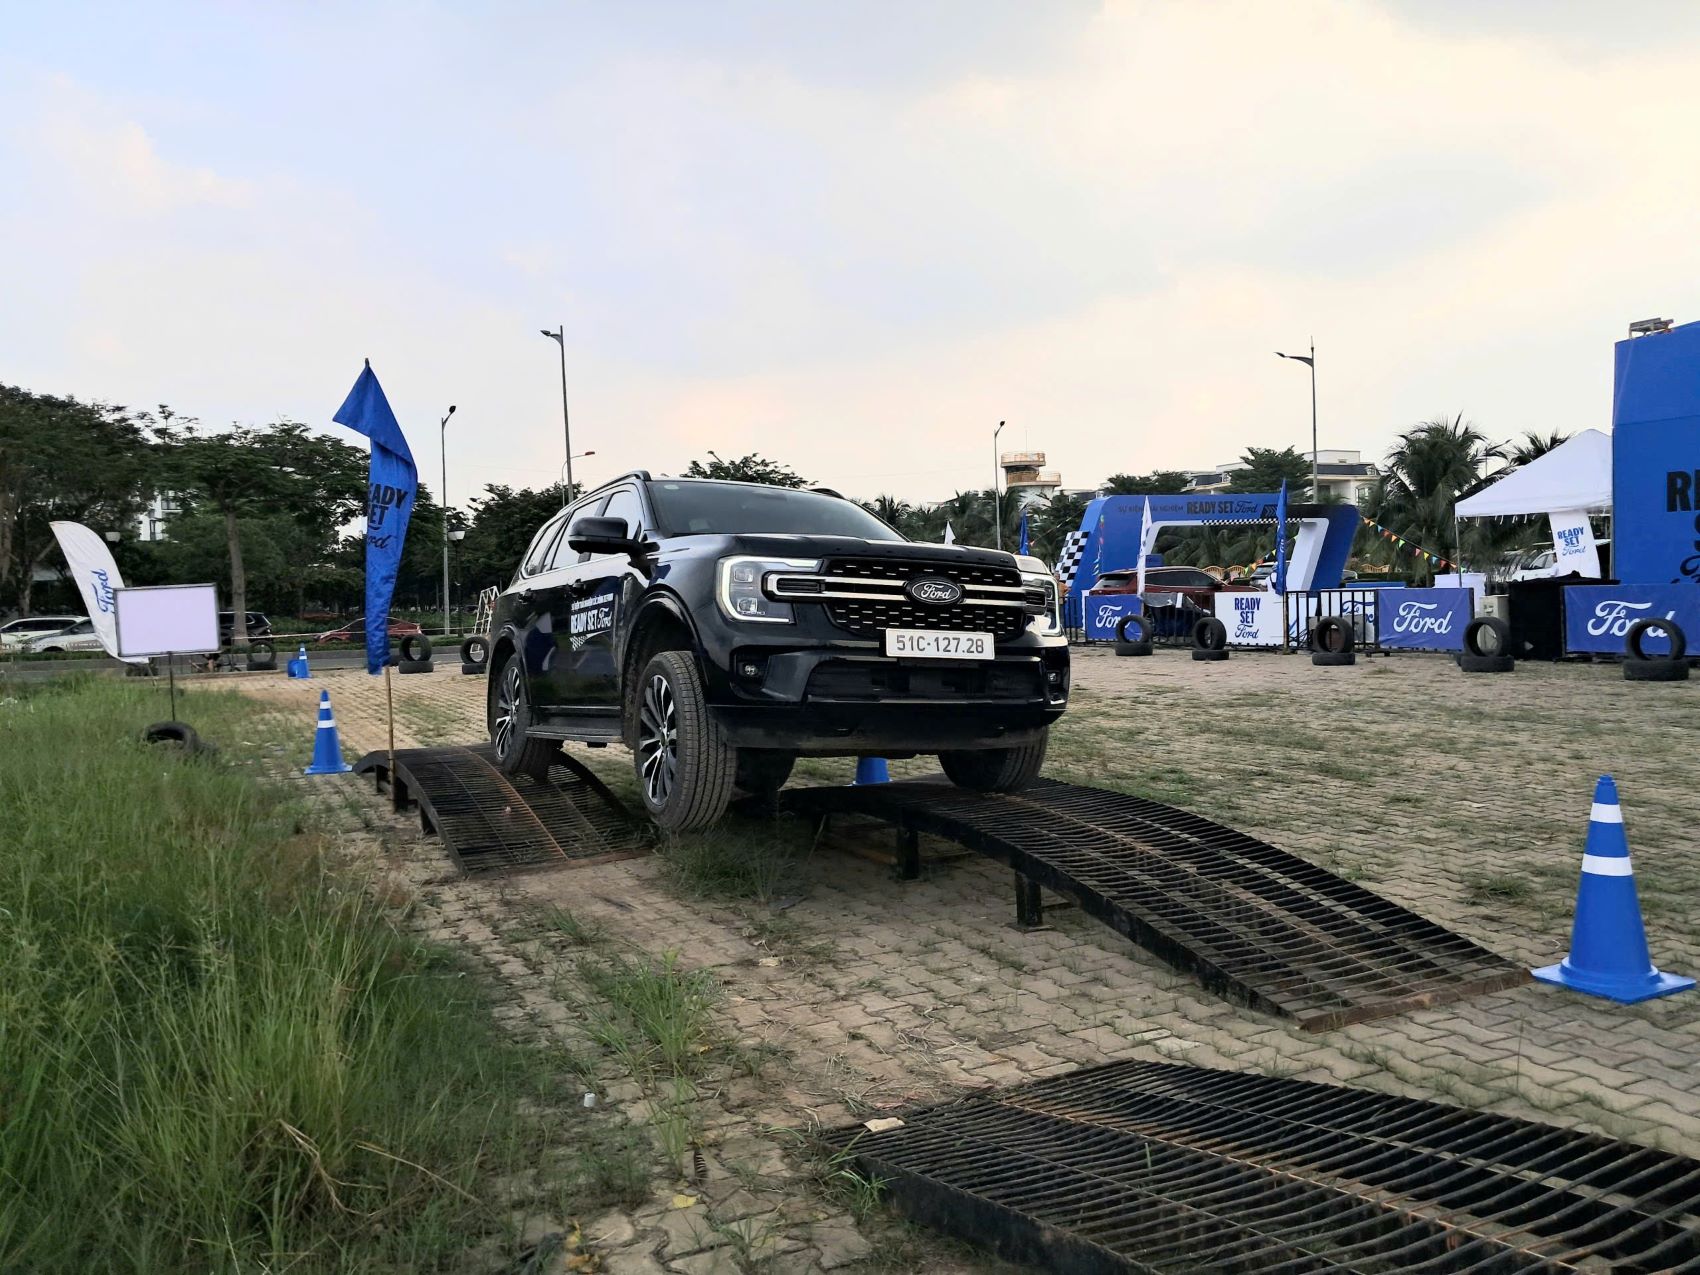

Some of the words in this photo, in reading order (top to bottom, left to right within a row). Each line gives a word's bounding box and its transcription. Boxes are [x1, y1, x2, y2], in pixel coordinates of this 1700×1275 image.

[368, 503, 389, 525] ET
[1187, 501, 1216, 514] READY
[1218, 501, 1234, 514] SET
[1234, 500, 1259, 513] Ford
[1557, 526, 1584, 540] READY
[1564, 535, 1580, 547] SET
[91, 568, 115, 614] Ford
[920, 583, 953, 600] Ford
[1234, 597, 1261, 611] READY
[1240, 610, 1255, 624] SET
[1393, 601, 1453, 634] Ford
[1234, 623, 1260, 639] Ford
